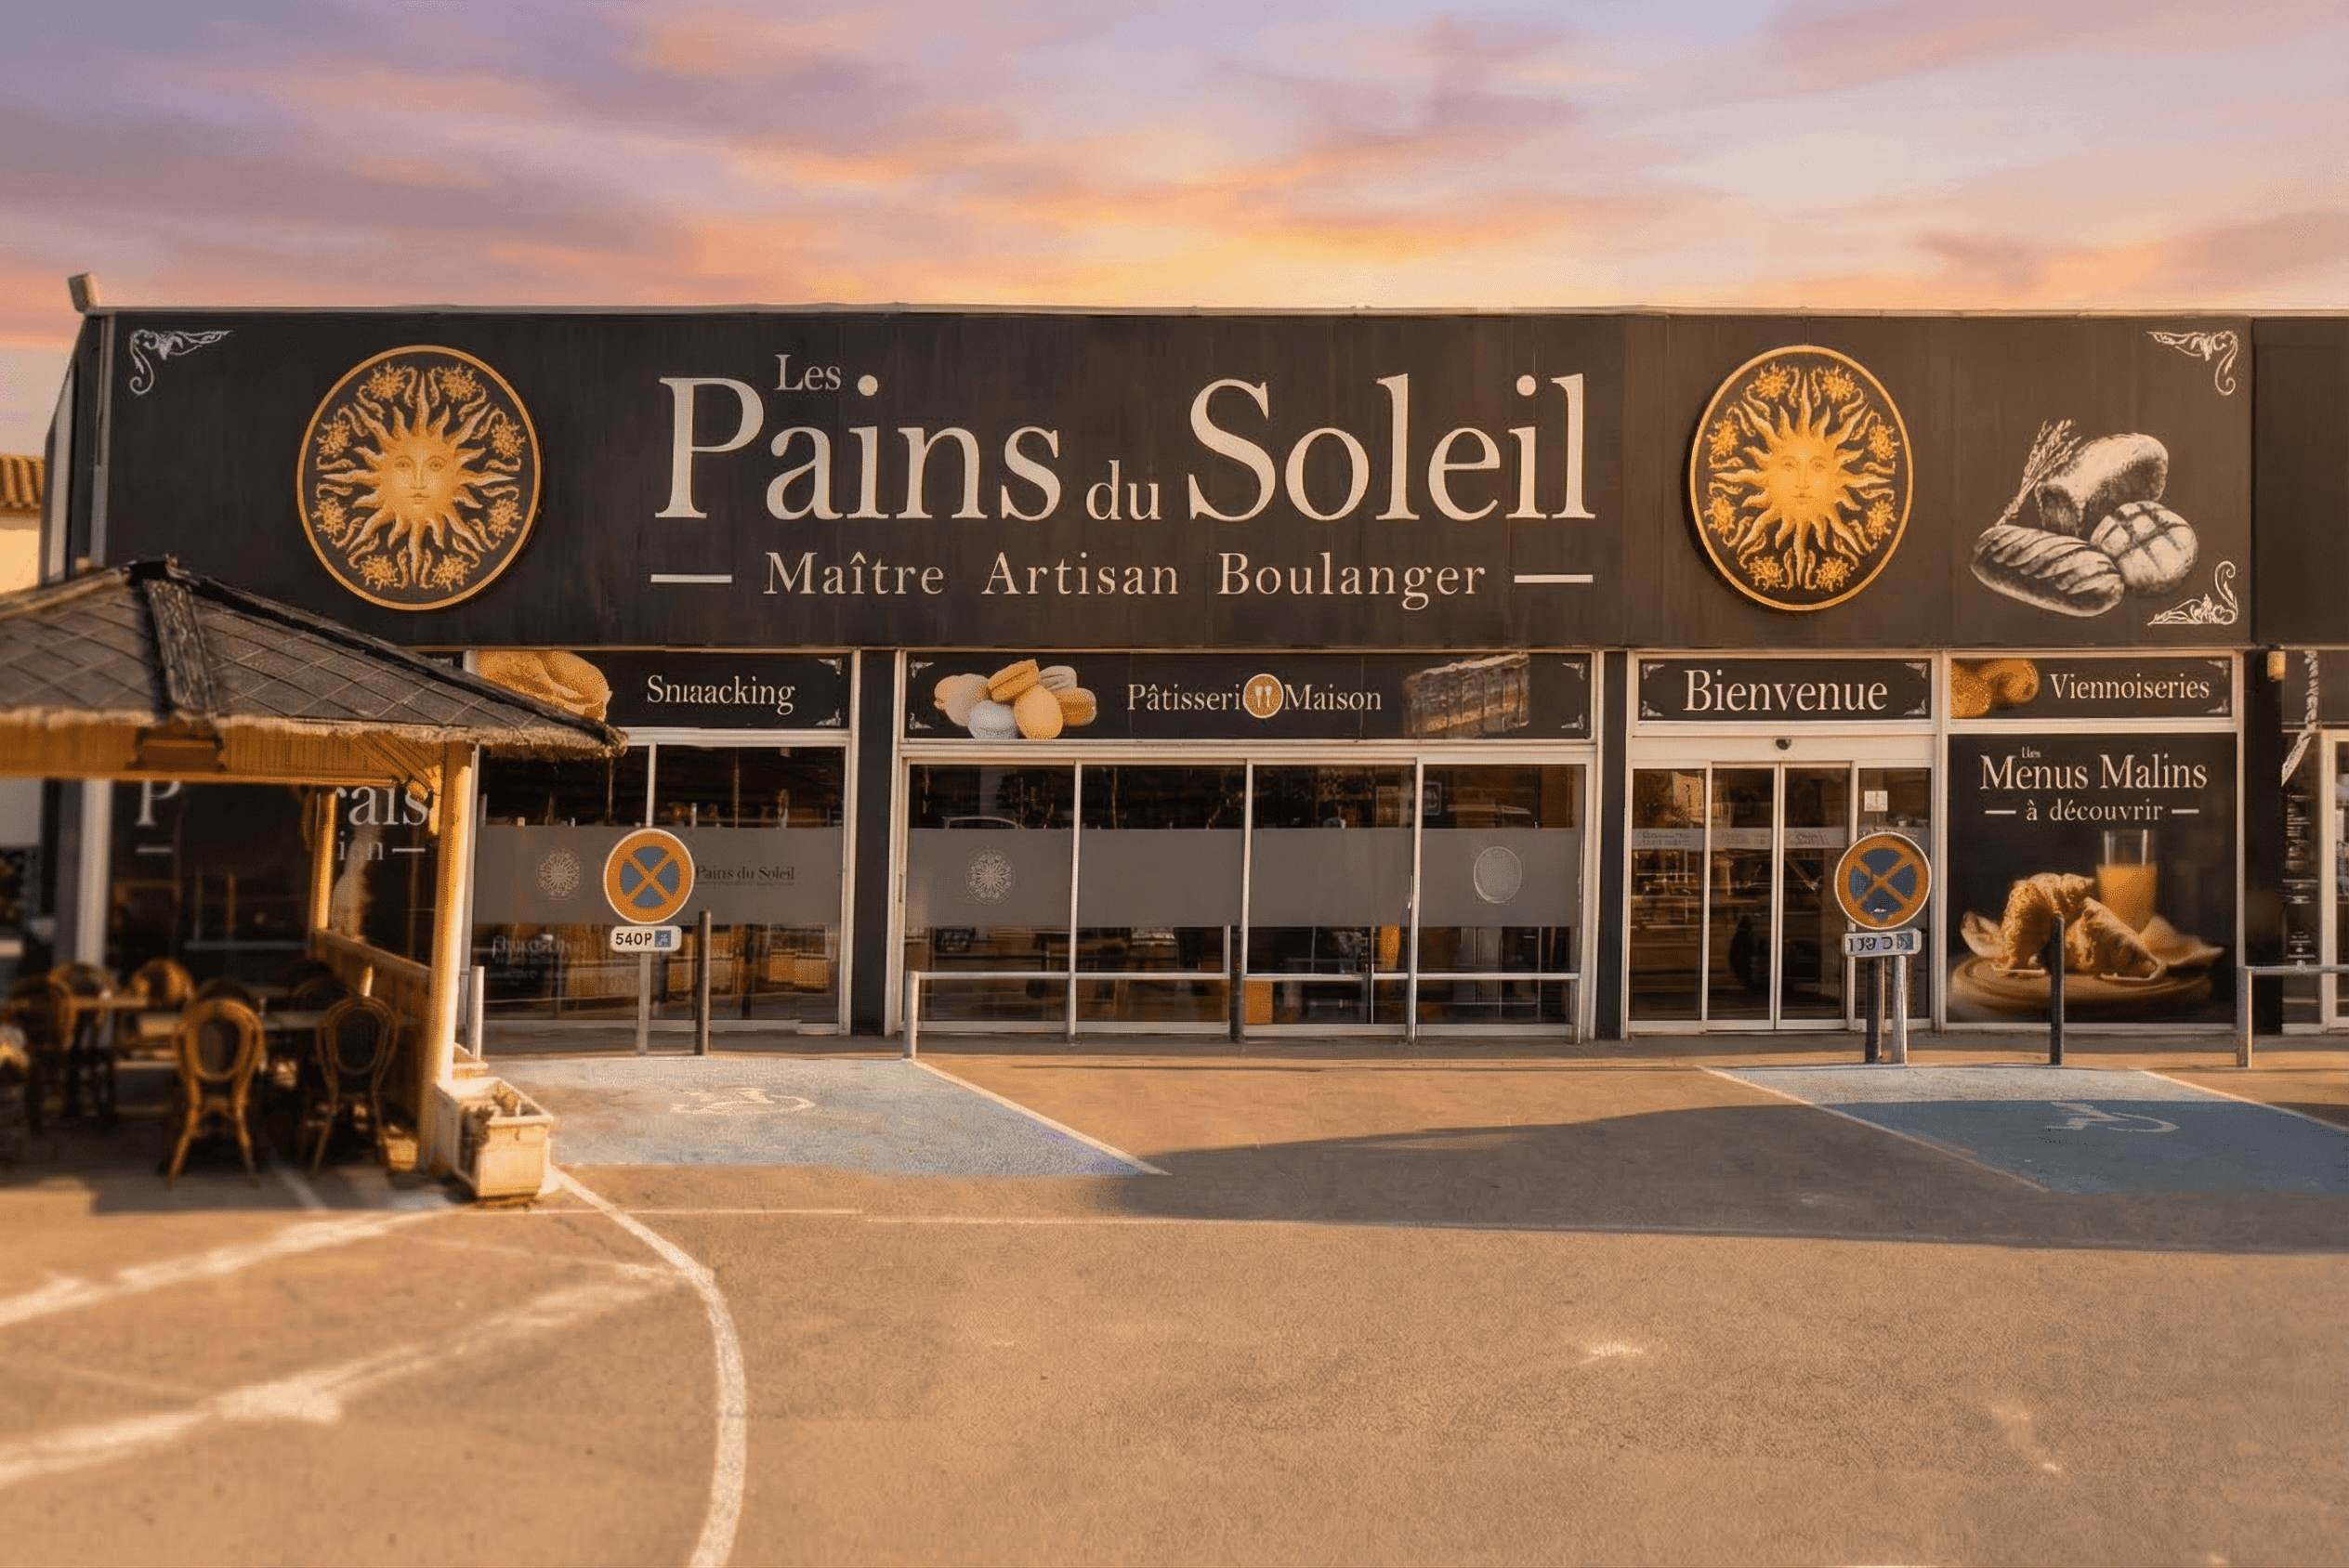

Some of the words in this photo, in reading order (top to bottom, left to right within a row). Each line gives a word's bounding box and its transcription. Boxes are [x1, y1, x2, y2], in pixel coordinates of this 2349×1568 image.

[775, 354, 842, 391] Les
[655, 373, 1062, 521] Pains
[1086, 460, 1161, 520] du
[1188, 373, 1596, 521] Soleil
[763, 551, 944, 595] Maître
[981, 552, 1179, 595] Artisan
[1217, 552, 1486, 610] Boulanger
[1285, 684, 1382, 711] Maison
[1683, 669, 1888, 712] Bienvenue
[2050, 673, 2210, 699] Viennoiseries
[1980, 754, 2089, 790] Menus
[2099, 753, 2208, 790] Malins
[2026, 799, 2038, 821] à
[2049, 799, 2163, 821] découvrir
[737, 866, 755, 880] du
[615, 933, 652, 946] 540P
